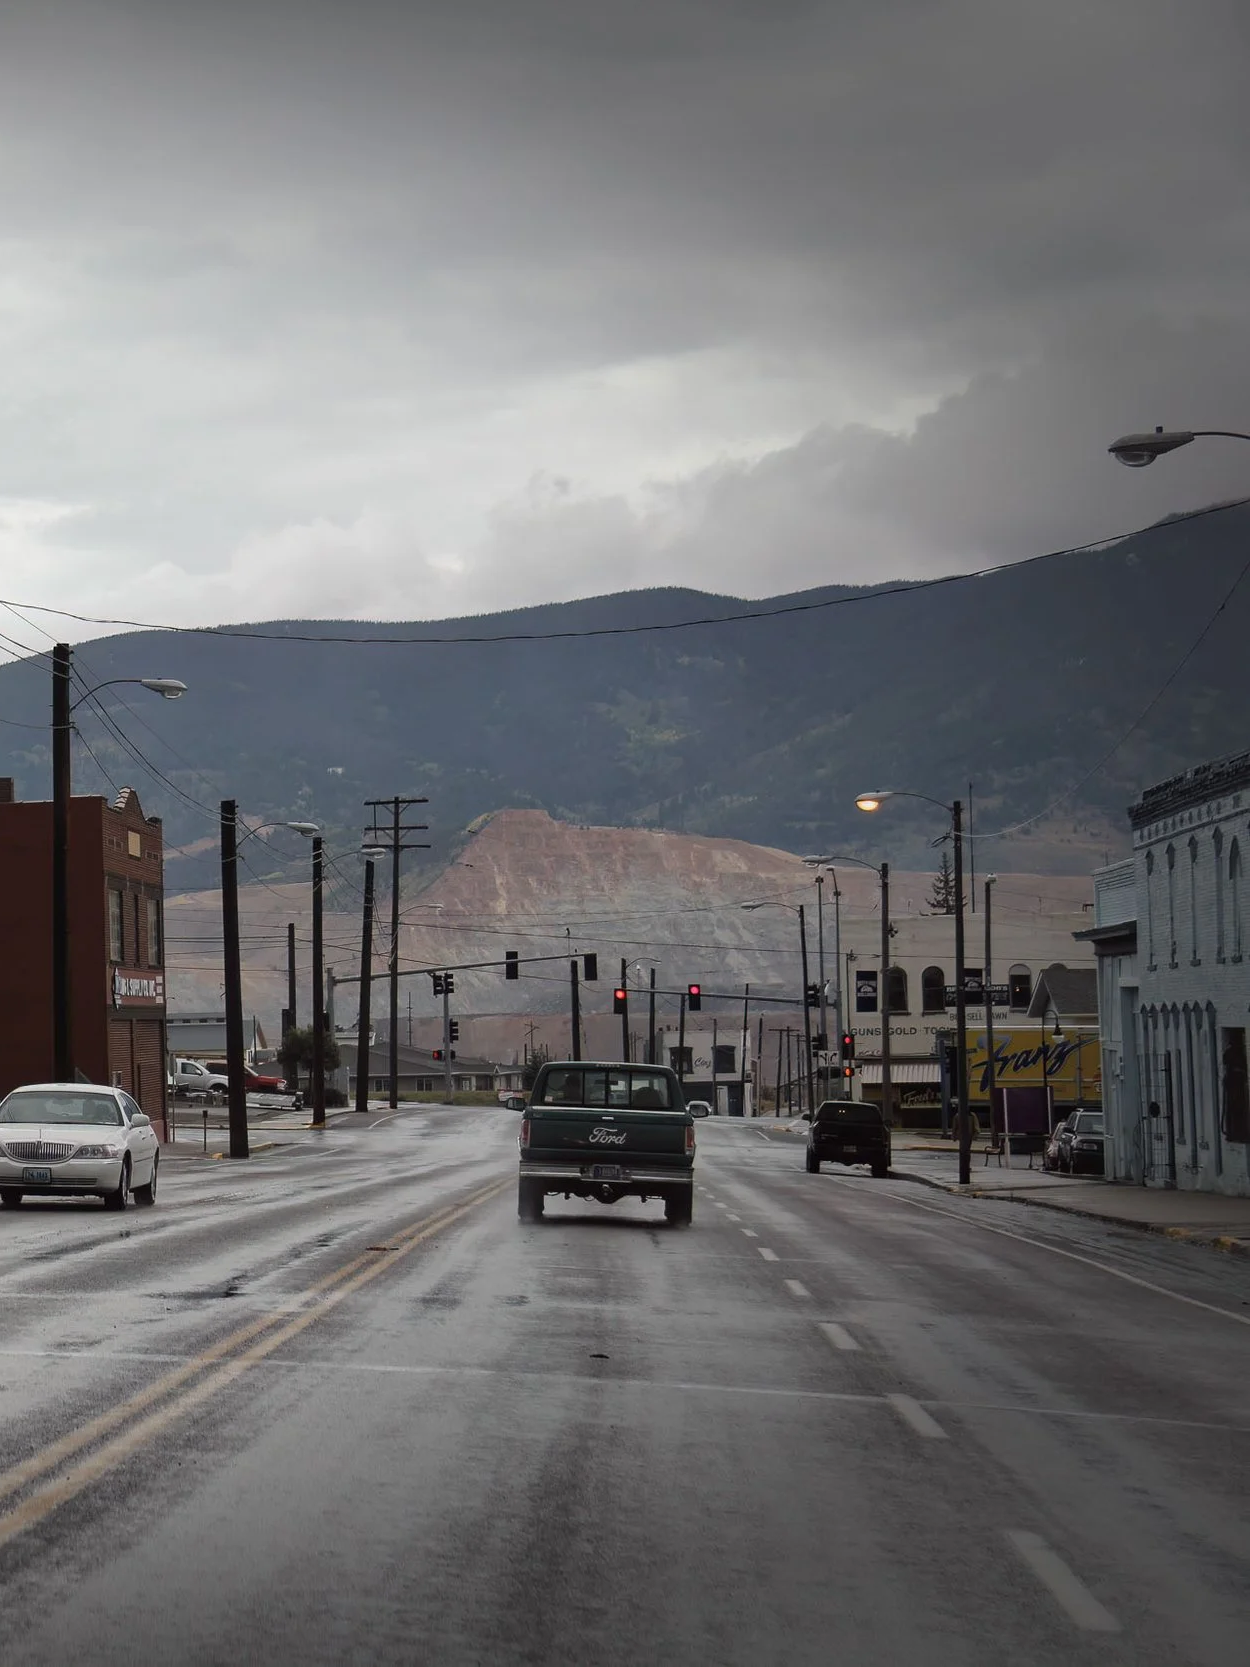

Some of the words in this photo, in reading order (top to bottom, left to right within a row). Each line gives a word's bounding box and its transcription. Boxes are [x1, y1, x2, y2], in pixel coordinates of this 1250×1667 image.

[966, 1012, 984, 1021] SELL
[991, 1011, 1008, 1020] AWN
[850, 1027, 882, 1037] GUNS
[887, 1026, 917, 1036] GOLD
[971, 1034, 1100, 1092] Franz
[588, 1127, 627, 1145] Ford
